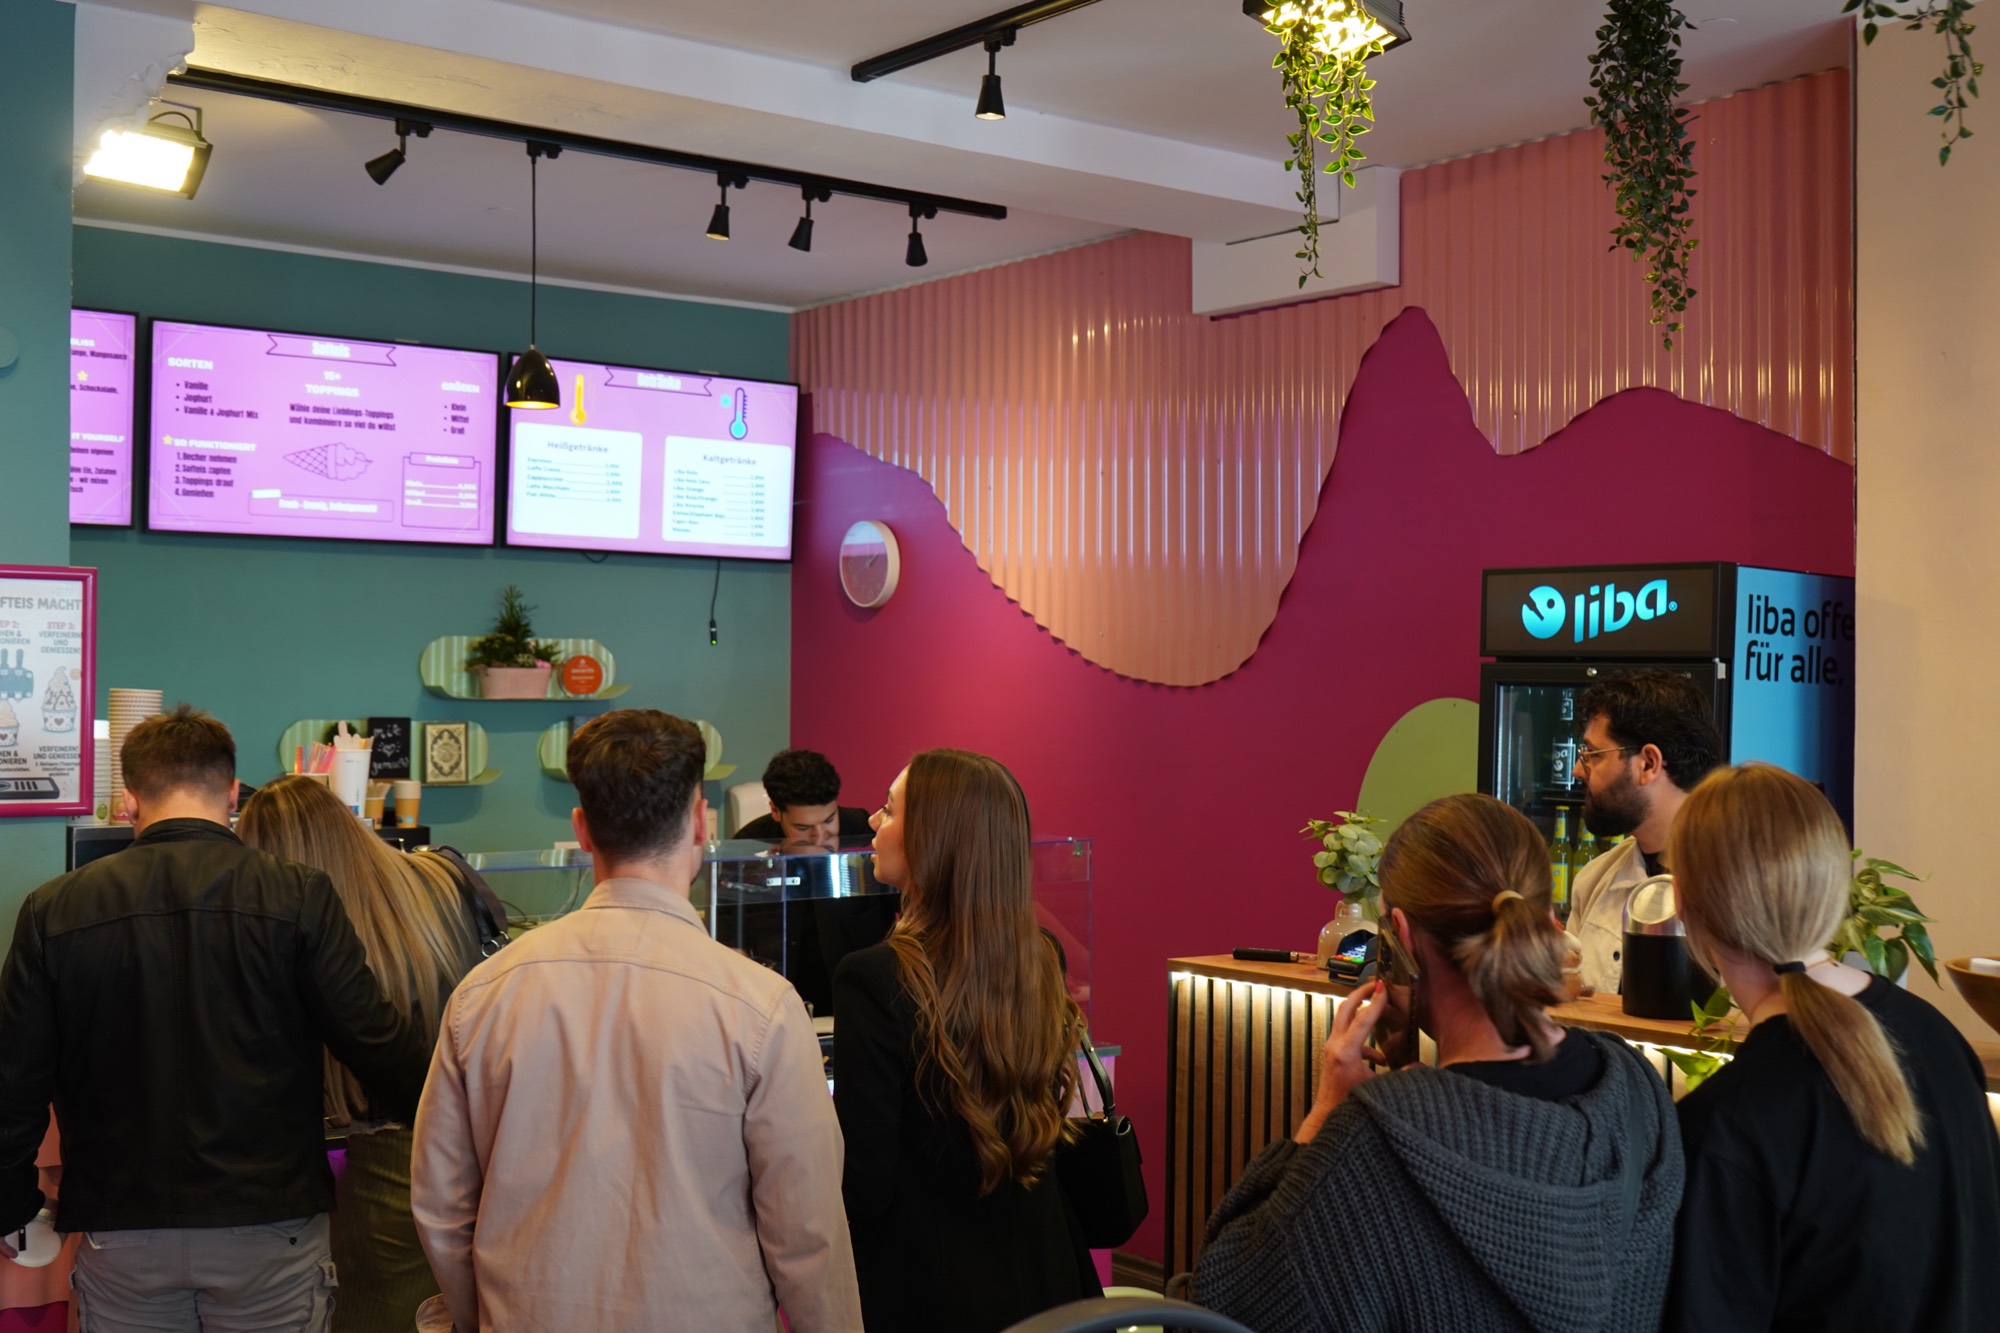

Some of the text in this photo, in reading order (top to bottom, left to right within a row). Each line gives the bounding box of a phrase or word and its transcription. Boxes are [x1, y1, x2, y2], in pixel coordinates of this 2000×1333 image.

[167, 357, 214, 370] SORTEN
[184, 380, 208, 390] Vanille
[304, 383, 360, 397] TOPPINGS
[184, 393, 212, 404] Joghurt
[184, 406, 208, 416] Vanille
[216, 408, 244, 419] Joghurt
[312, 404, 330, 414] deine
[289, 416, 302, 424] und
[82, 433, 126, 443] YOURSELF
[174, 438, 188, 447] SO
[547, 440, 609, 454] Heißgetränke
[182, 452, 207, 462] Becher
[209, 454, 237, 464] nehmen
[703, 454, 757, 466] Kaltgetränke
[182, 464, 206, 474] Softeis
[208, 466, 232, 476] zapfen
[182, 476, 214, 486] Toppings
[216, 478, 234, 487] drauf
[182, 488, 214, 498] Genießen
[37, 598, 82, 611] MACHT
[1574, 579, 1668, 643] liba
[1748, 594, 1795, 637] liba
[47, 621, 66, 630] STEP
[0, 630, 22, 638] HEN &
[1745, 640, 1842, 686] für alle.
